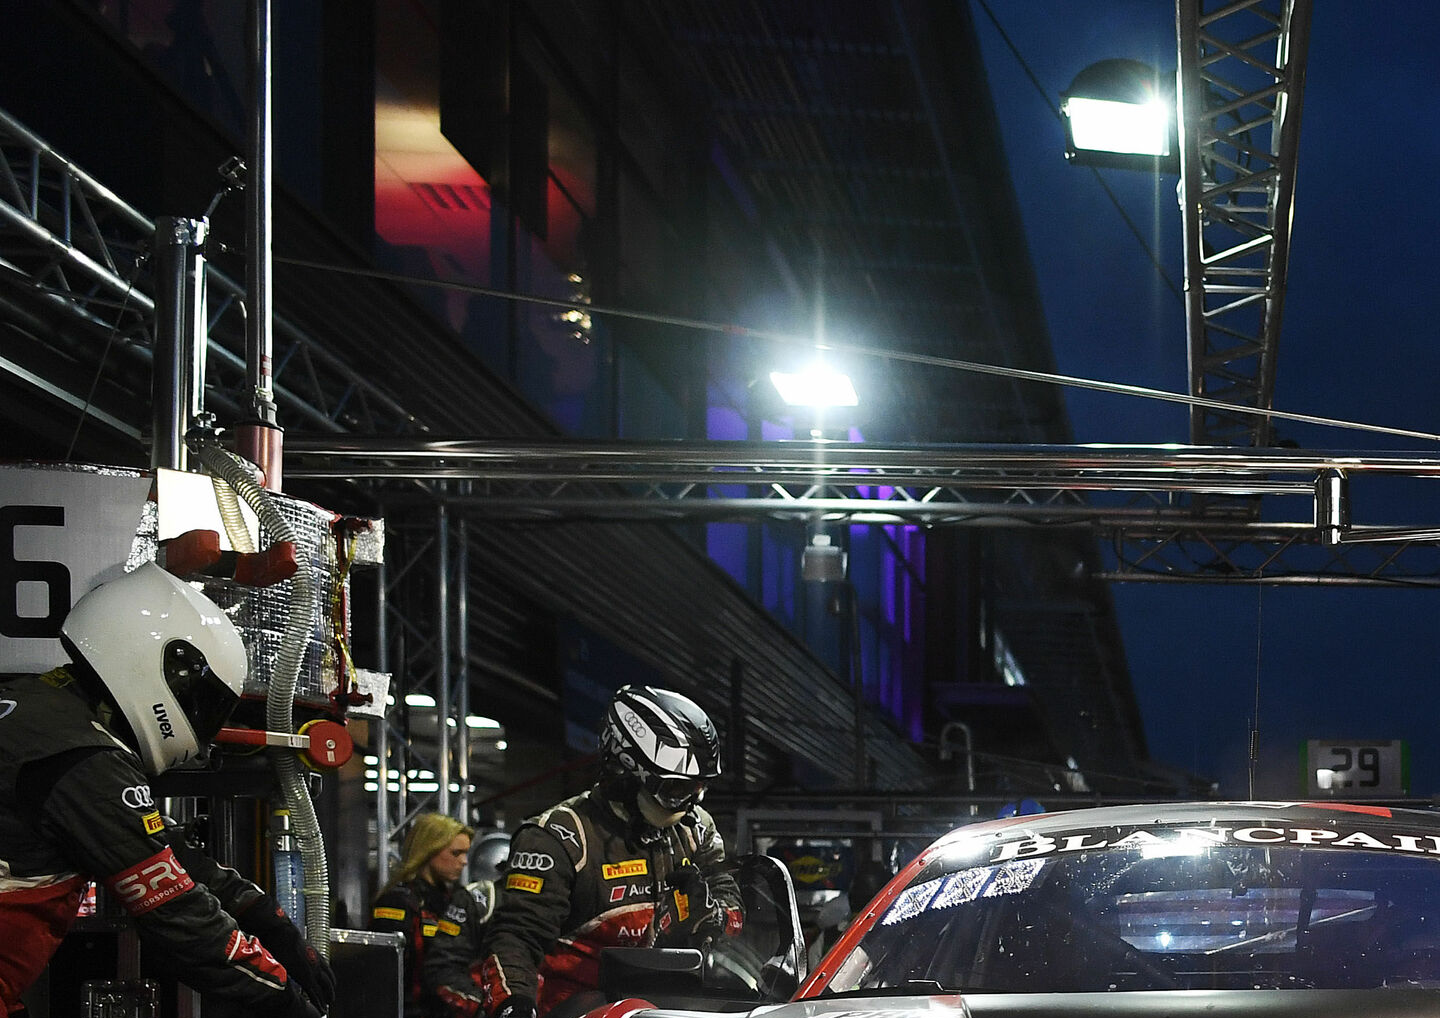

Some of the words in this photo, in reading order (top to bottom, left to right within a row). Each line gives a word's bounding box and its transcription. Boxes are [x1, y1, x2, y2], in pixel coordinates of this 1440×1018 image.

[0, 505, 71, 639] 6
[152, 702, 175, 740] uvex
[1329, 747, 1380, 788] 29
